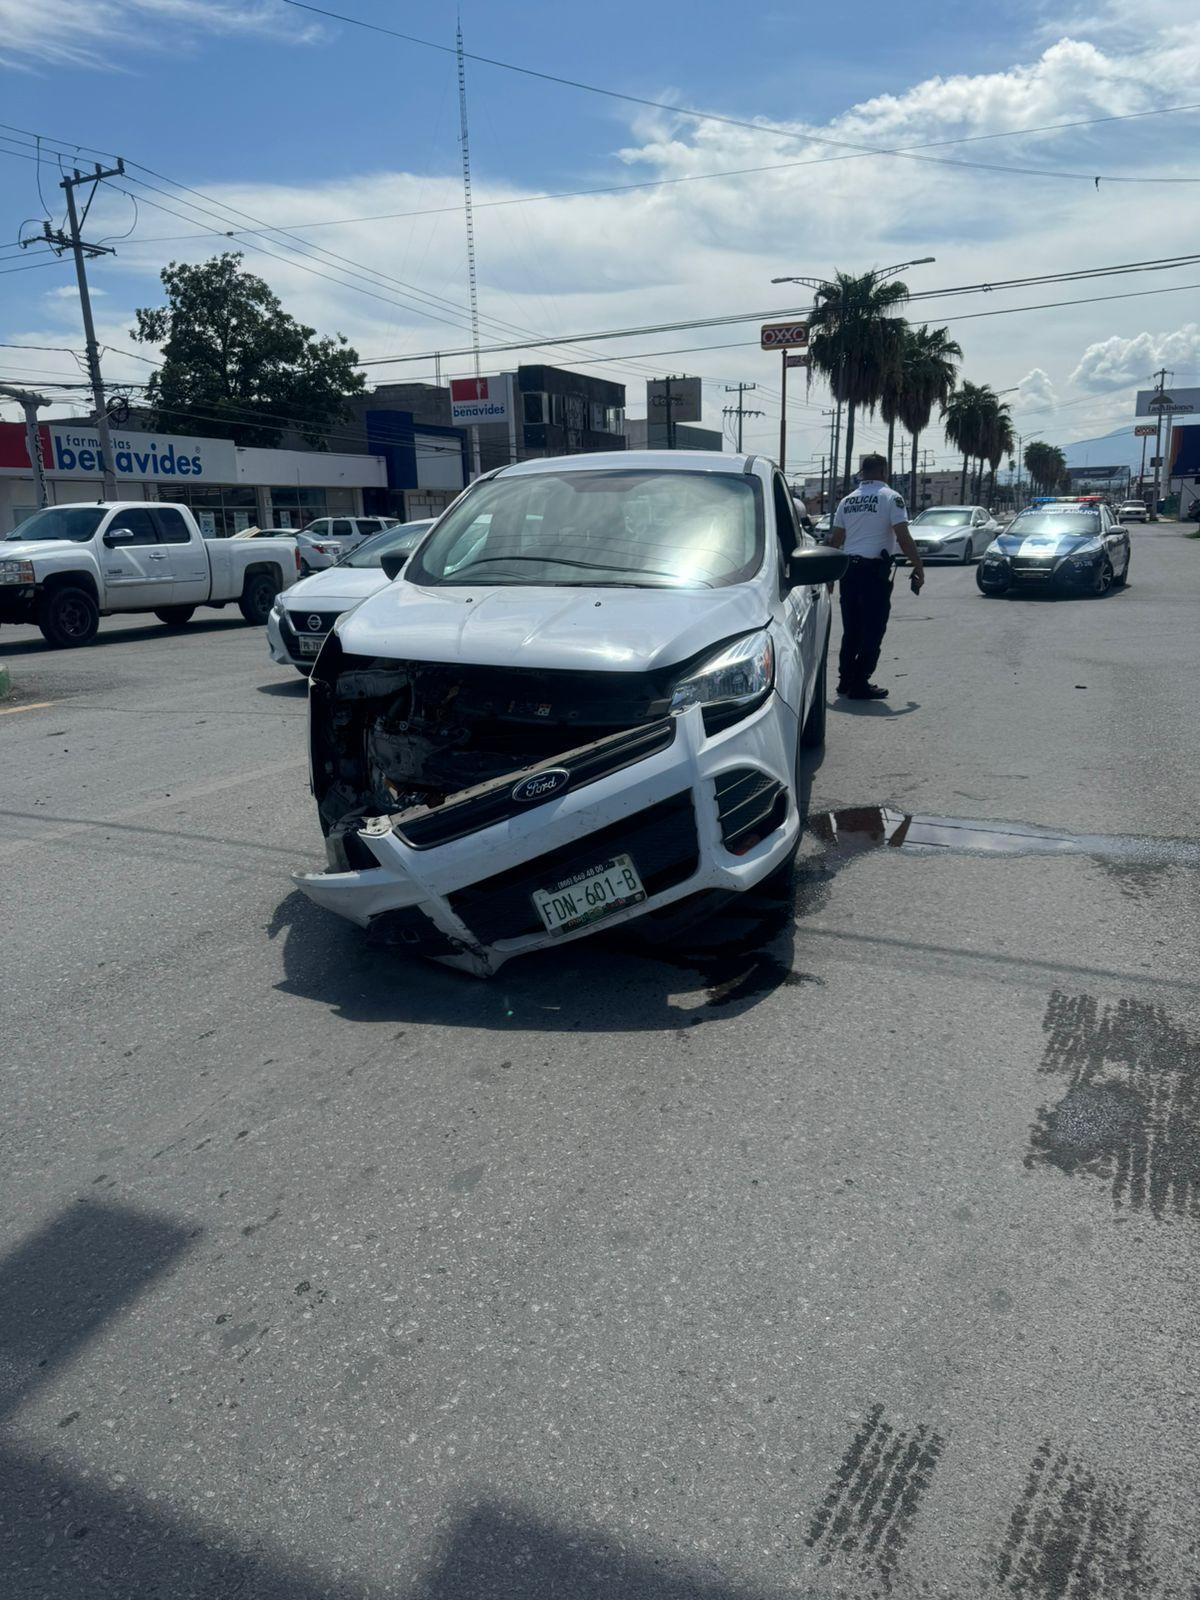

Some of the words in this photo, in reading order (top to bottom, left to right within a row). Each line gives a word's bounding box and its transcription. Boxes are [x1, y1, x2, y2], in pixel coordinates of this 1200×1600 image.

[763, 328, 806, 344] OXXO
[453, 403, 505, 417] benavides
[66, 434, 131, 449] farmias
[844, 503, 878, 514] MUNICIPAL
[526, 776, 557, 797] Ford
[542, 868, 637, 925] FDN-601-B
